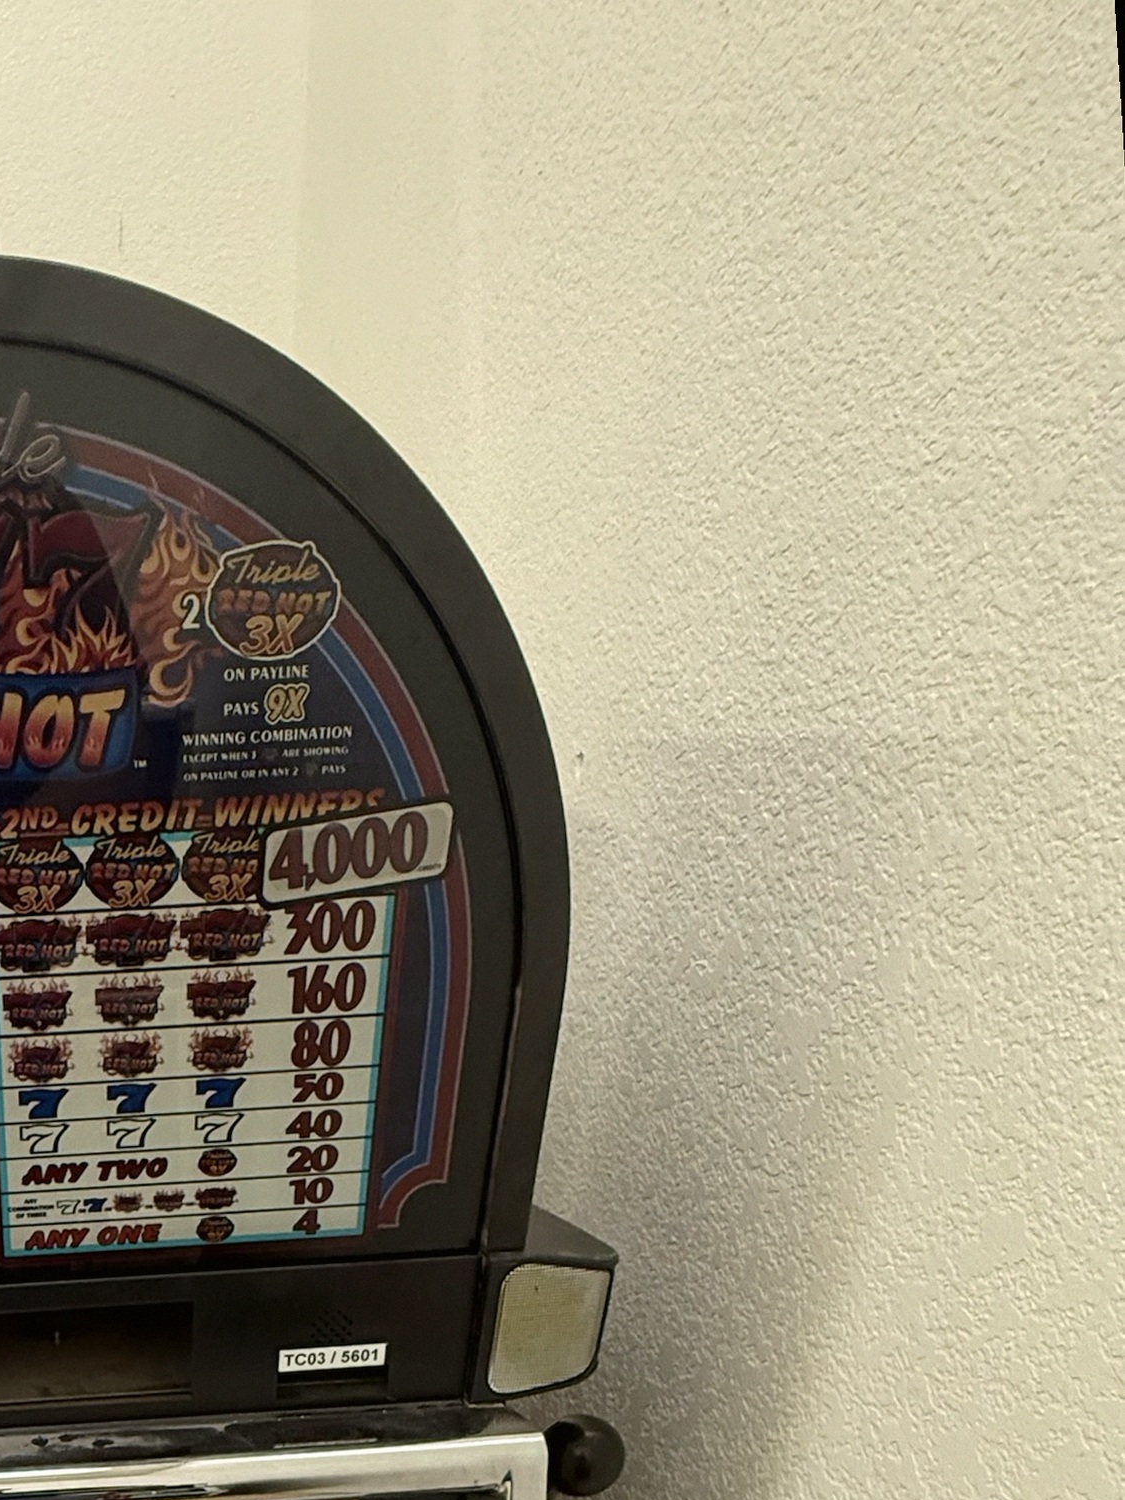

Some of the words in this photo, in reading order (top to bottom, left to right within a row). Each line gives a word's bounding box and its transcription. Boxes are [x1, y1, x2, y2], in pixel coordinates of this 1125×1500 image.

[228, 549, 320, 584] Triple
[182, 595, 200, 629] 2
[274, 590, 331, 614] HOT
[239, 612, 305, 655] 3X
[224, 667, 245, 682] ON
[250, 664, 309, 681] PAYLINE
[223, 702, 259, 717] PAYS
[265, 684, 308, 724] 9X
[182, 731, 246, 746] WINNING
[250, 725, 353, 743] COMBINATION
[183, 753, 218, 764] EXCEPT
[282, 746, 300, 757] ARE
[303, 745, 349, 756] SHOWING
[200, 770, 238, 781] PAYLINE
[321, 763, 347, 775] PAYS
[0, 806, 57, 838] 2ND
[70, 800, 199, 835] CREDIT
[268, 810, 428, 892] 4,000
[283, 900, 376, 955] 300
[286, 962, 366, 1015] 160
[290, 1019, 351, 1069] 80
[293, 1072, 344, 1102] 50
[285, 1110, 342, 1138] 40
[21, 1163, 87, 1186] ANY
[97, 1157, 168, 1180] TWO
[286, 1144, 338, 1173] 20
[288, 1178, 334, 1205] 10
[25, 1229, 89, 1250] ANY
[97, 1224, 162, 1245] ONE
[292, 1210, 319, 1235] 4
[284, 1352, 326, 1368] TC03
[341, 1349, 379, 1364] 5601
